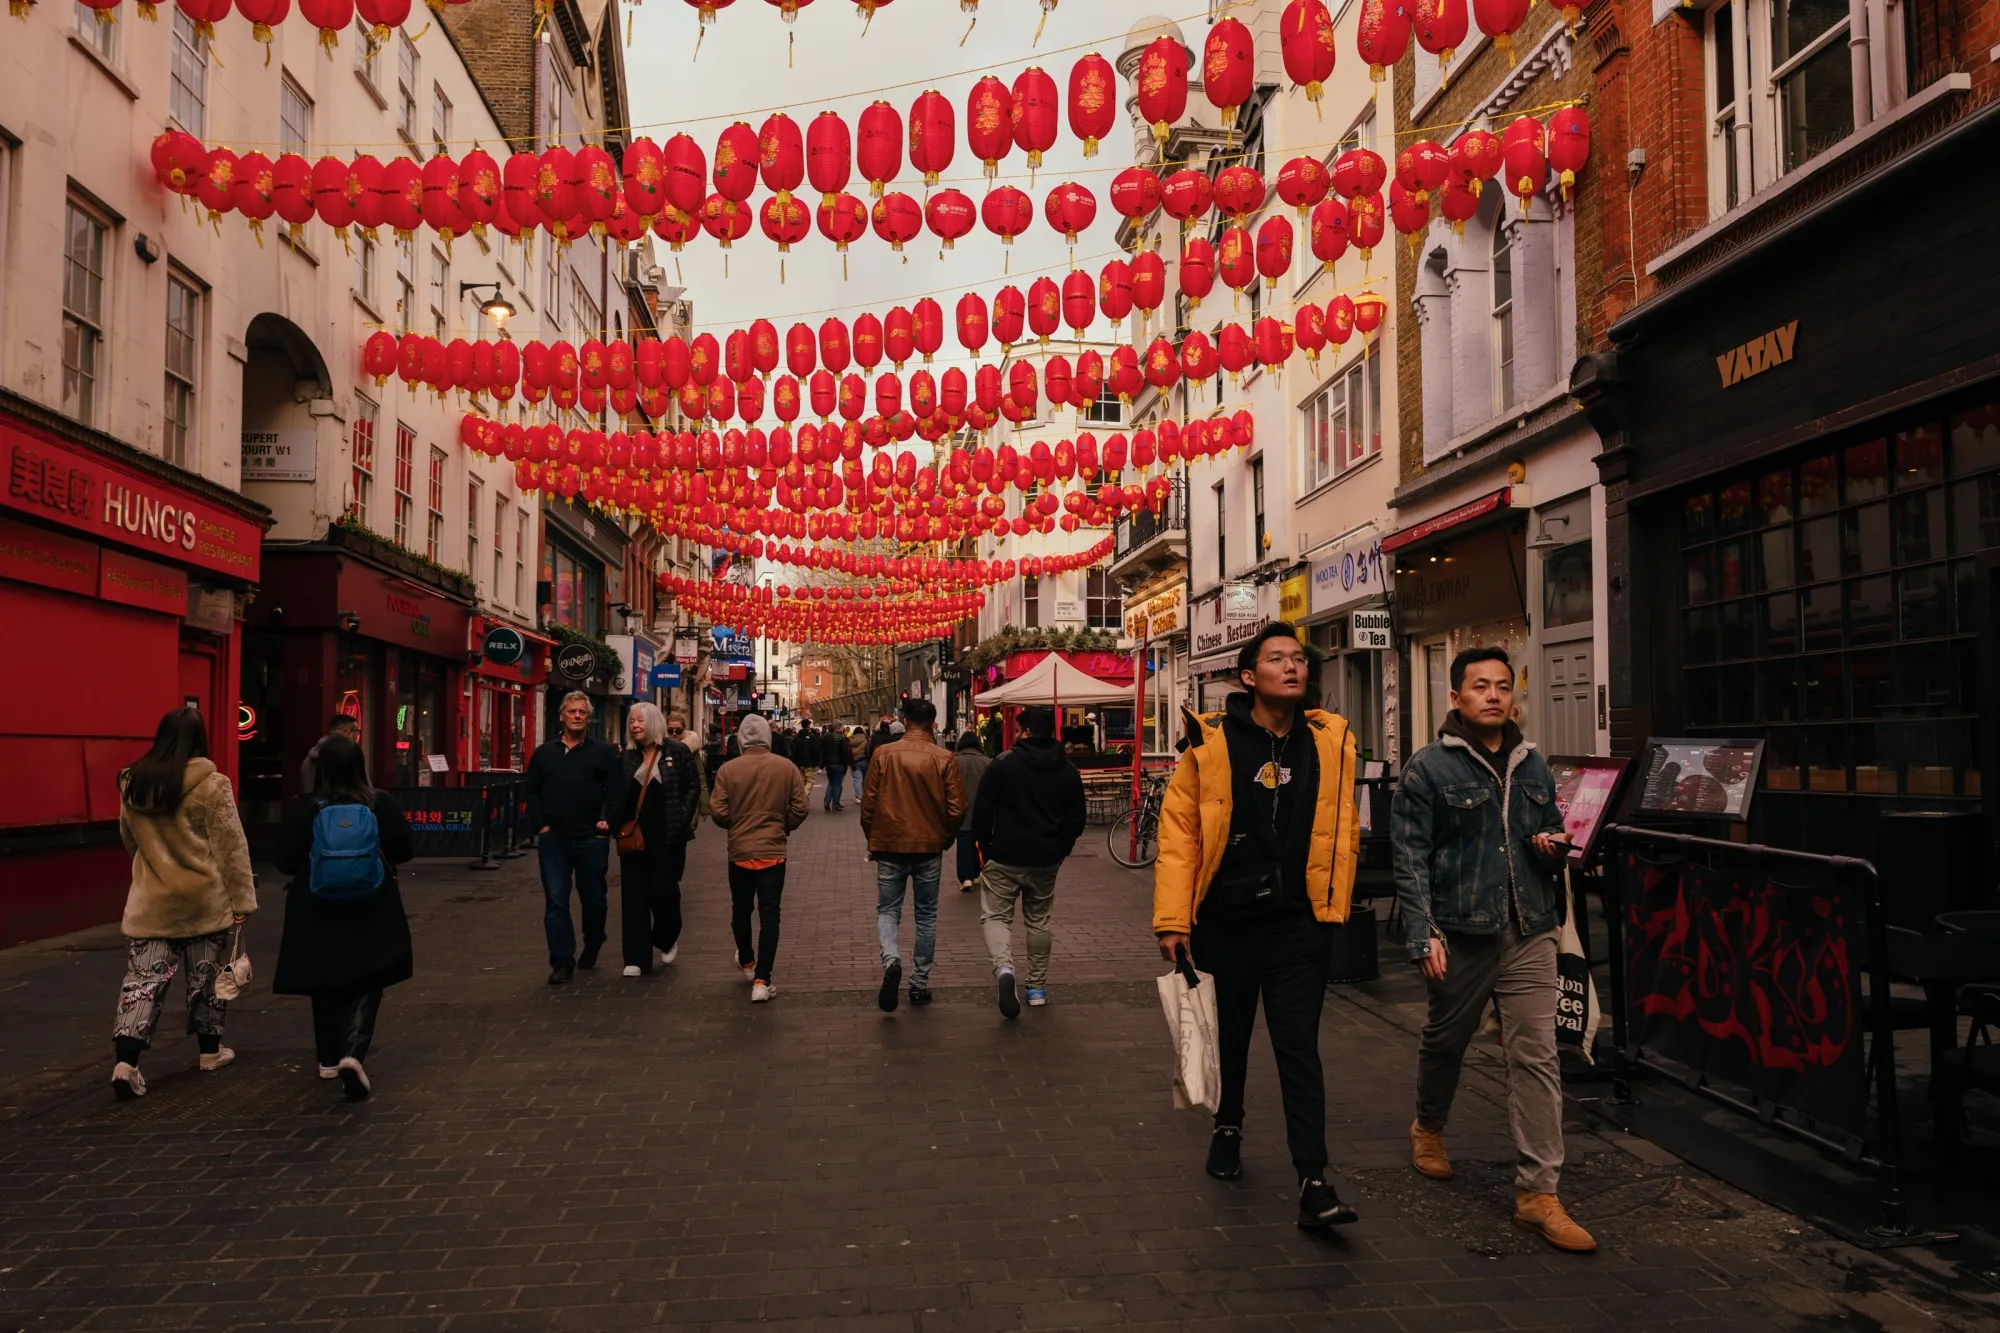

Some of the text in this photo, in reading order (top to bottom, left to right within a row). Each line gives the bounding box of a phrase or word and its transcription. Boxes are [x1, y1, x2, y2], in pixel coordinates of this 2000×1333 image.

[673, 166, 701, 179] CASINO
[1716, 319, 1800, 389] YATAY
[275, 446, 291, 455] W1
[103, 481, 196, 551] HUNG'S
[199, 519, 237, 545] CHINESE
[199, 540, 254, 569] RESTAURANT
[107, 567, 152, 593] Restaurant
[1316, 564, 1339, 584] WOO TEA
[1355, 614, 1390, 629] Bubble
[1197, 613, 1271, 652] Chinese Restaurant
[1368, 631, 1386, 646] Tea
[488, 641, 517, 650] RELX
[560, 653, 592, 669] O'Neill's
[446, 810, 472, 824] 그릴
